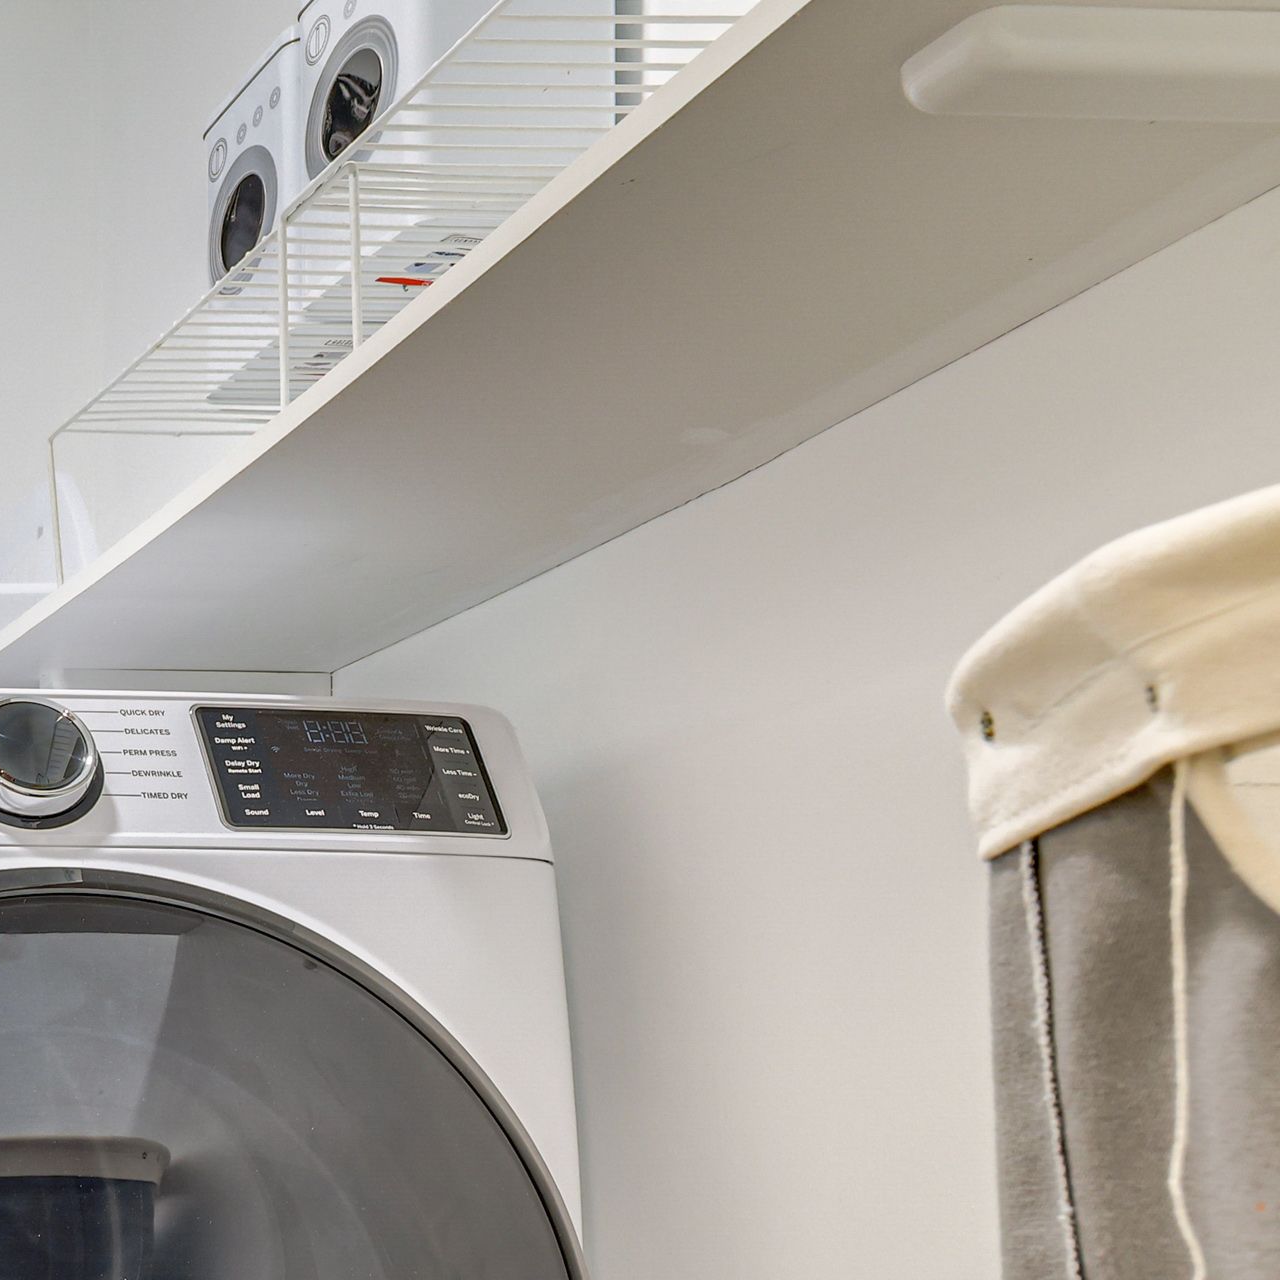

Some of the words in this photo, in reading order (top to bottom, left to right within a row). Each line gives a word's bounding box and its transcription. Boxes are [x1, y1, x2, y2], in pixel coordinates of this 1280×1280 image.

[120, 709, 146, 717] QUICK
[216, 721, 246, 729] Settings
[424, 724, 448, 733] Wrinkle
[214, 737, 236, 745] Damp
[149, 749, 177, 757] PRESS
[433, 745, 449, 753] More
[131, 769, 183, 778] DEWRINKLE
[442, 768, 457, 776] Less
[141, 791, 169, 799] TIMED
[170, 792, 188, 800] DRY
[241, 791, 260, 799] Load
[458, 793, 480, 801] ecoDry
[244, 808, 270, 816] Sound
[359, 810, 380, 818] Temp
[467, 812, 485, 821] Light
